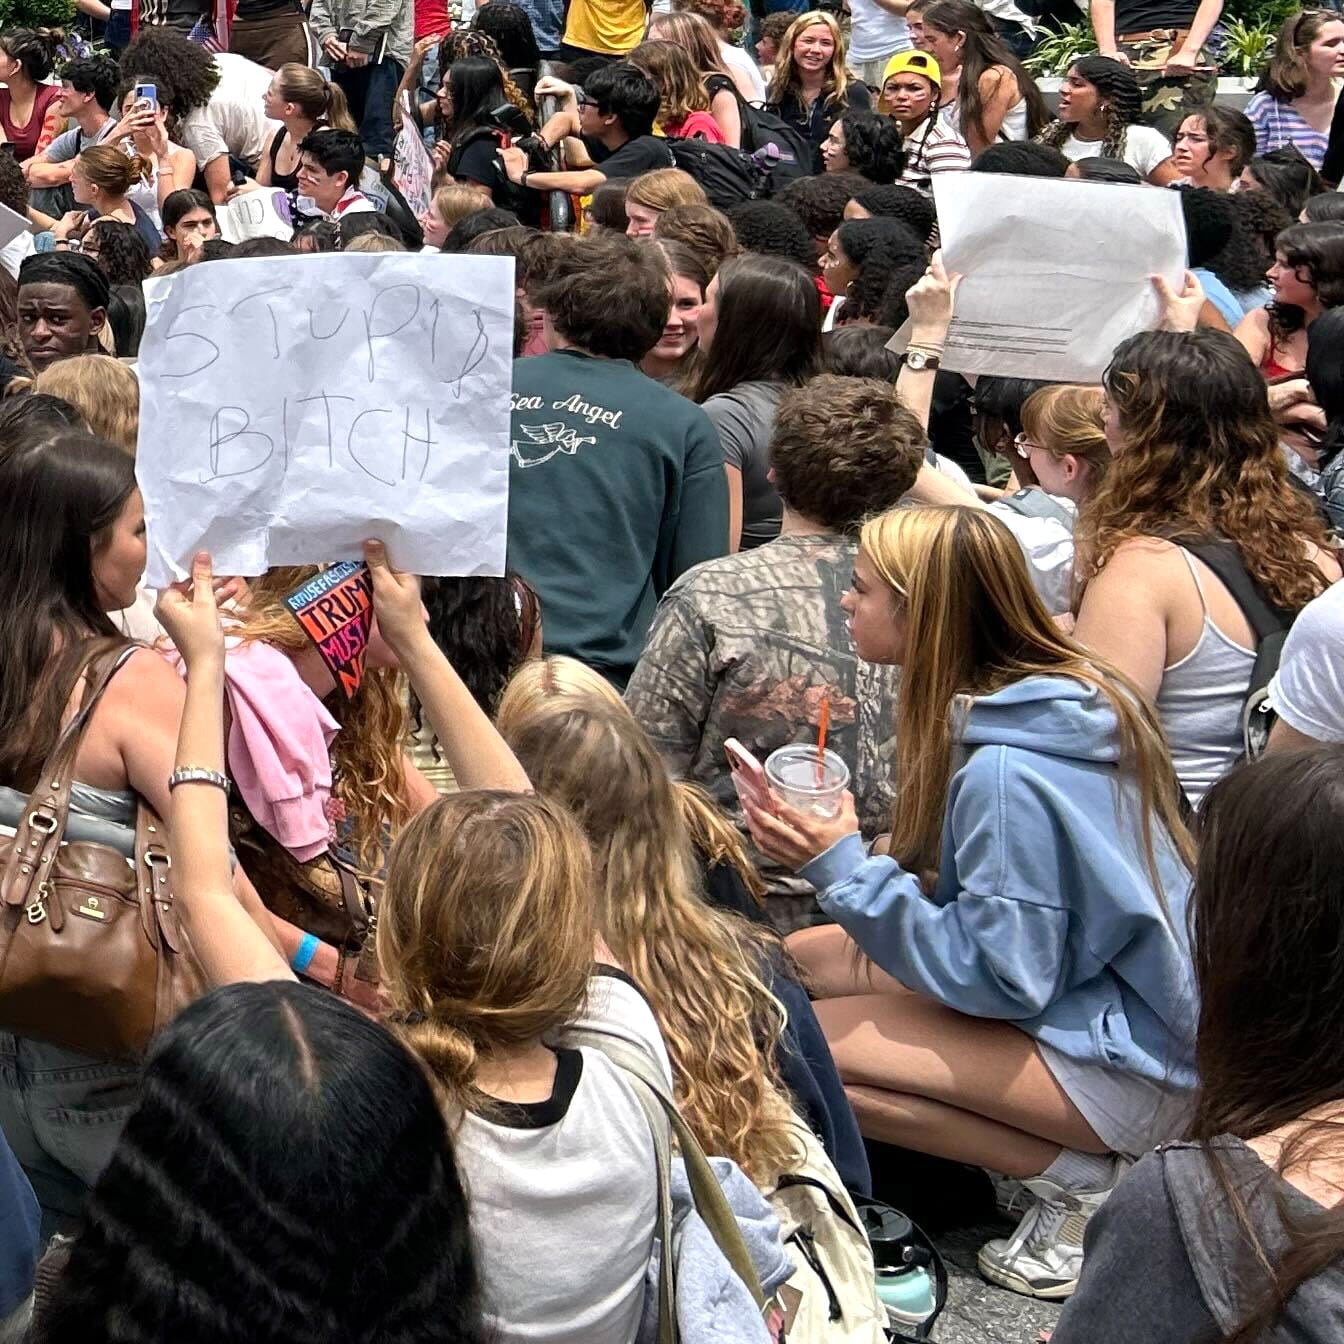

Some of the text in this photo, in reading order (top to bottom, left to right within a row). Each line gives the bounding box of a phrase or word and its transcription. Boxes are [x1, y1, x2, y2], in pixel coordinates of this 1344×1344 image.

[160, 284, 489, 399] STUPID
[198, 390, 439, 487] BITCH
[552, 394, 623, 430] Angel
